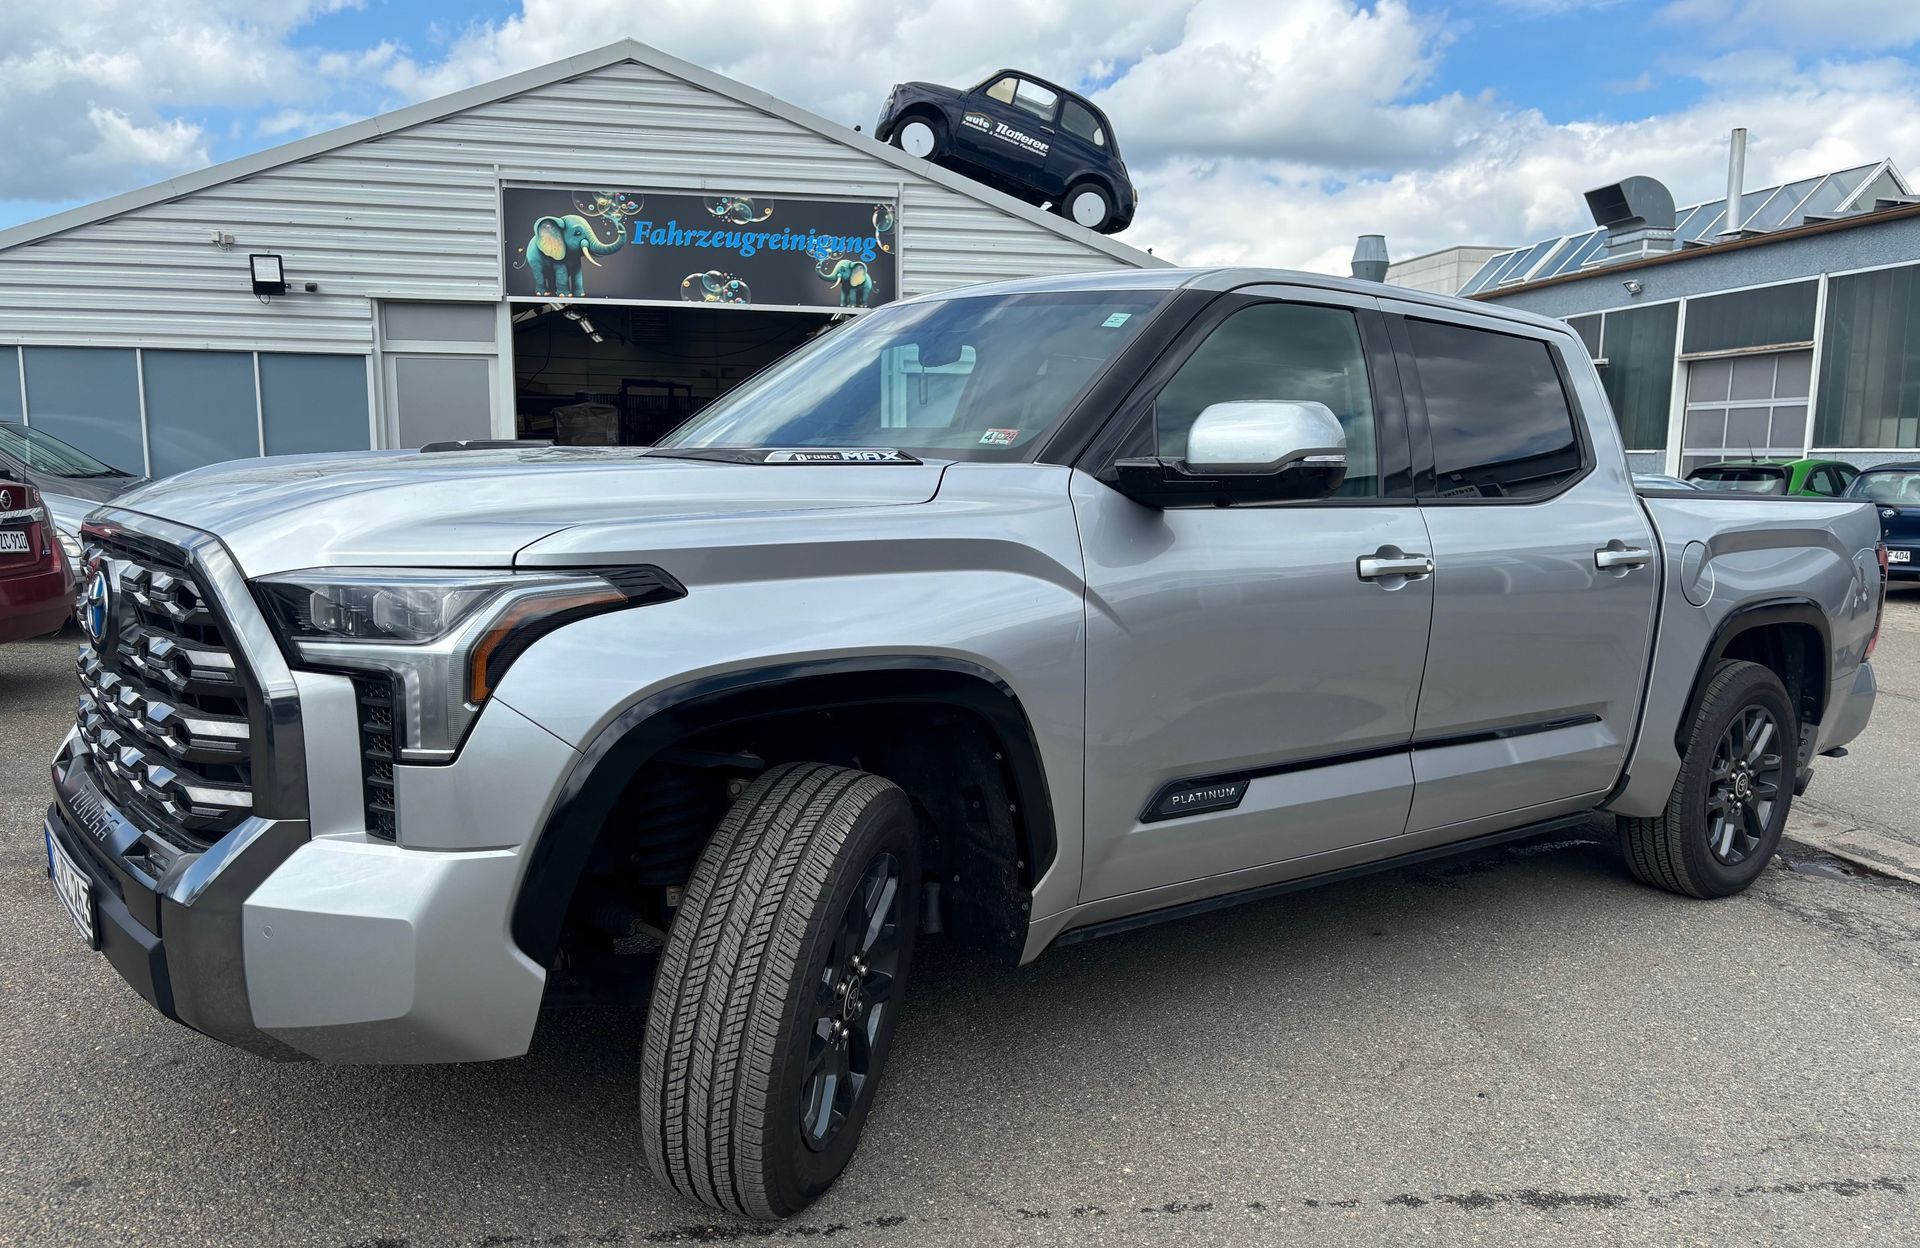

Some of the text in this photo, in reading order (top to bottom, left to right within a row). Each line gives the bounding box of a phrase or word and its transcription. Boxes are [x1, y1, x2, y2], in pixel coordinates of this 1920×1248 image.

[965, 116, 990, 128] auto
[631, 220, 878, 263] Fahrzeugreinigung
[839, 451, 900, 461] MAX
[1172, 787, 1236, 805] PLATINUM
